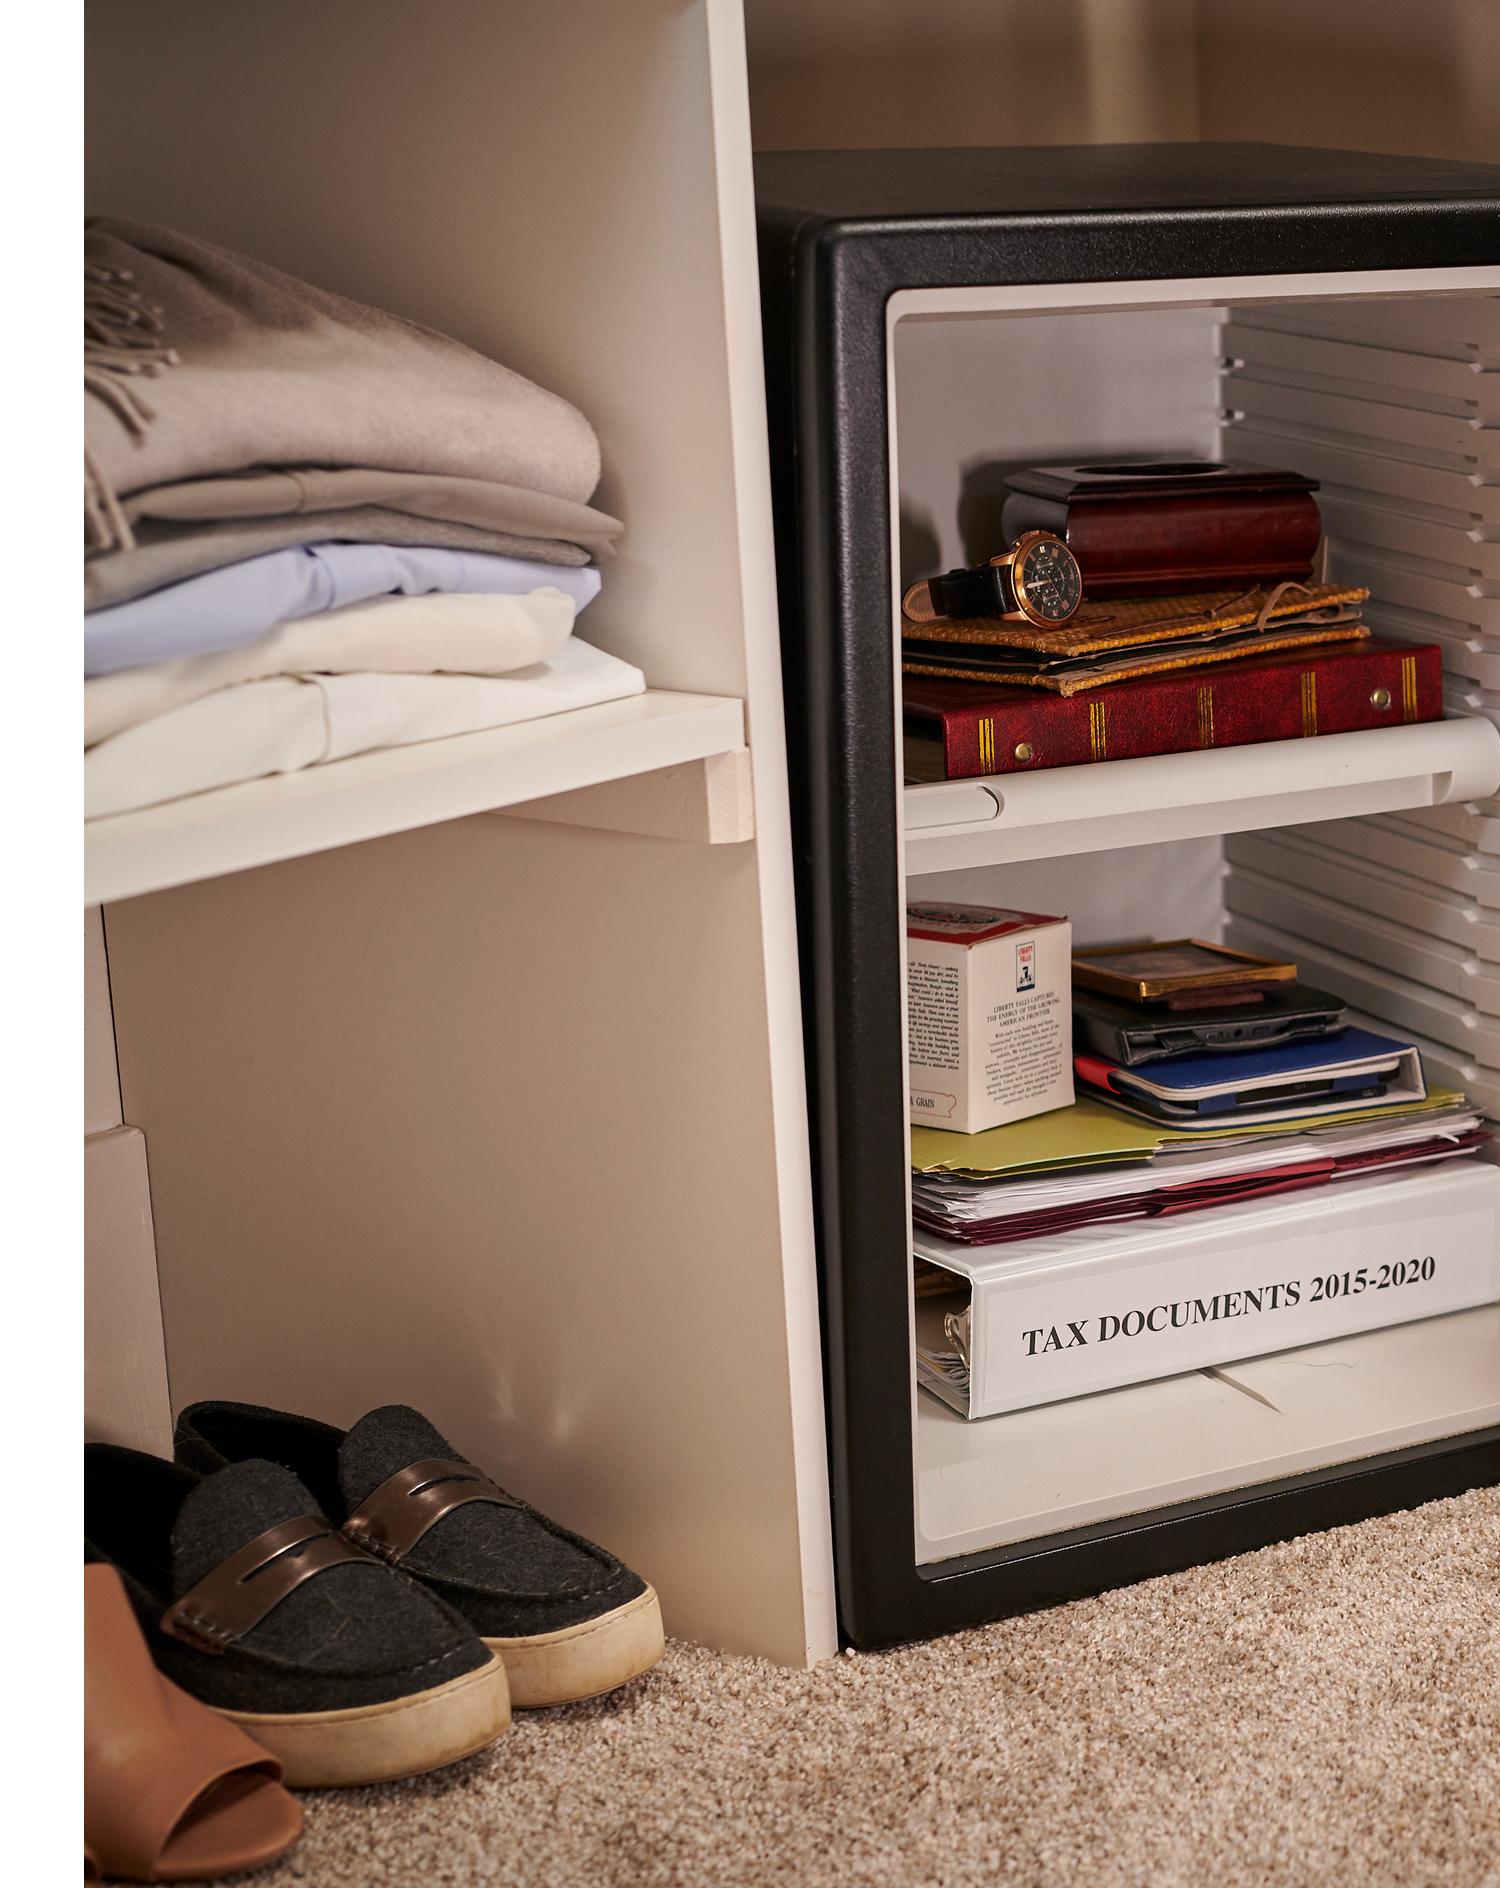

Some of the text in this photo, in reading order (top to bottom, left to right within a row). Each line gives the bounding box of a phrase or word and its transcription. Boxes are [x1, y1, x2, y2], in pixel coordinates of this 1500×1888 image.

[987, 1015, 998, 1023] THE
[999, 1010, 1018, 1020] ENERGY
[1027, 1004, 1037, 1012] THE
[1038, 998, 1060, 1010] GROWING
[994, 991, 1055, 1013] LIBERTY FALLS CAPTURES
[1000, 1008, 1050, 1027] AMERICAN FRONTIER
[916, 1096, 935, 1109] GRAIN
[1022, 1256, 1436, 1357] TAX DOCUMENTS 2015-2020
